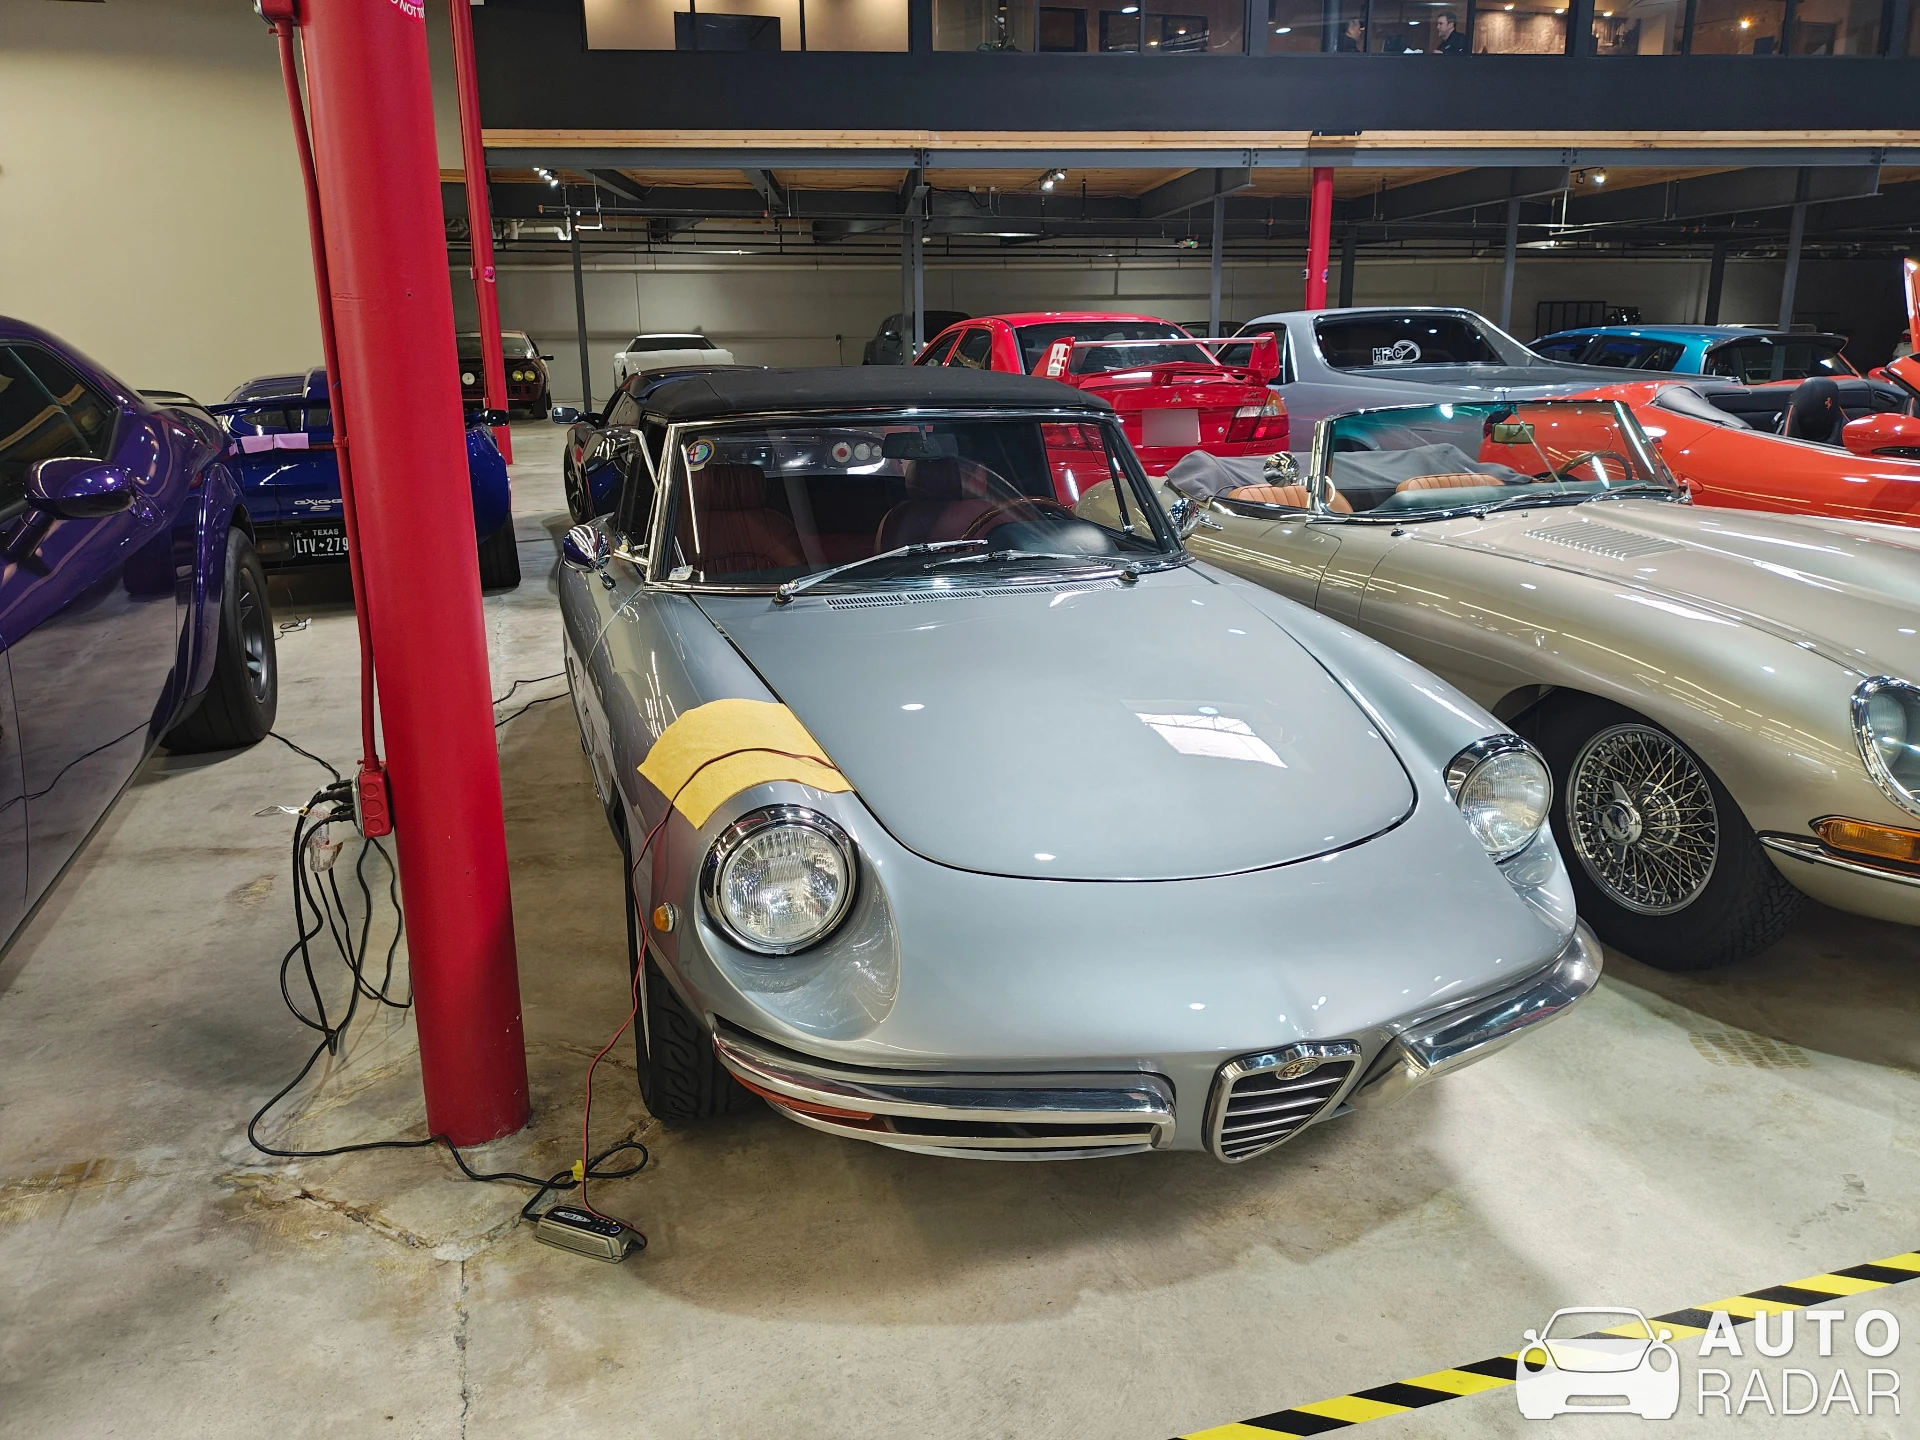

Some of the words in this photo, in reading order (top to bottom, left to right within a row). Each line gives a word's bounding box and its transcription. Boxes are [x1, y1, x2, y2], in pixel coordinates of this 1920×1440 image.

[400, 0, 416, 17] NOT
[312, 528, 339, 536] TEXAS
[296, 538, 316, 553] LTV
[326, 537, 349, 552] 279
